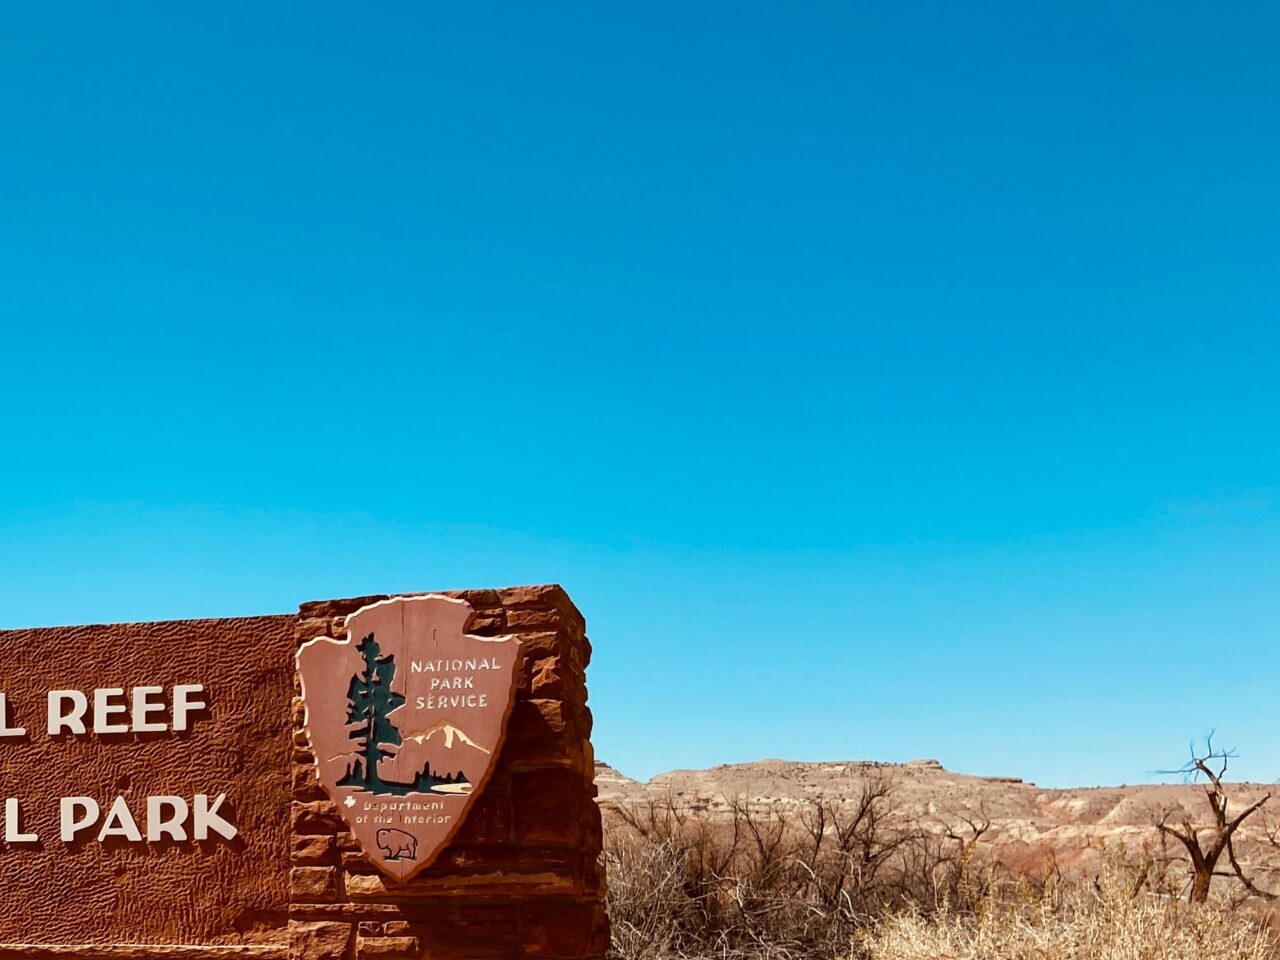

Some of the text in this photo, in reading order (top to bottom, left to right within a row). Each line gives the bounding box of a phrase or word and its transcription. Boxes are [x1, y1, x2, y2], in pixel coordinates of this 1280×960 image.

[410, 656, 502, 674] NATIONAL
[430, 676, 475, 690] PARK
[48, 684, 207, 735] REEF
[416, 694, 488, 710] SERVICE
[60, 793, 239, 842] PARK
[356, 814, 368, 824] of
